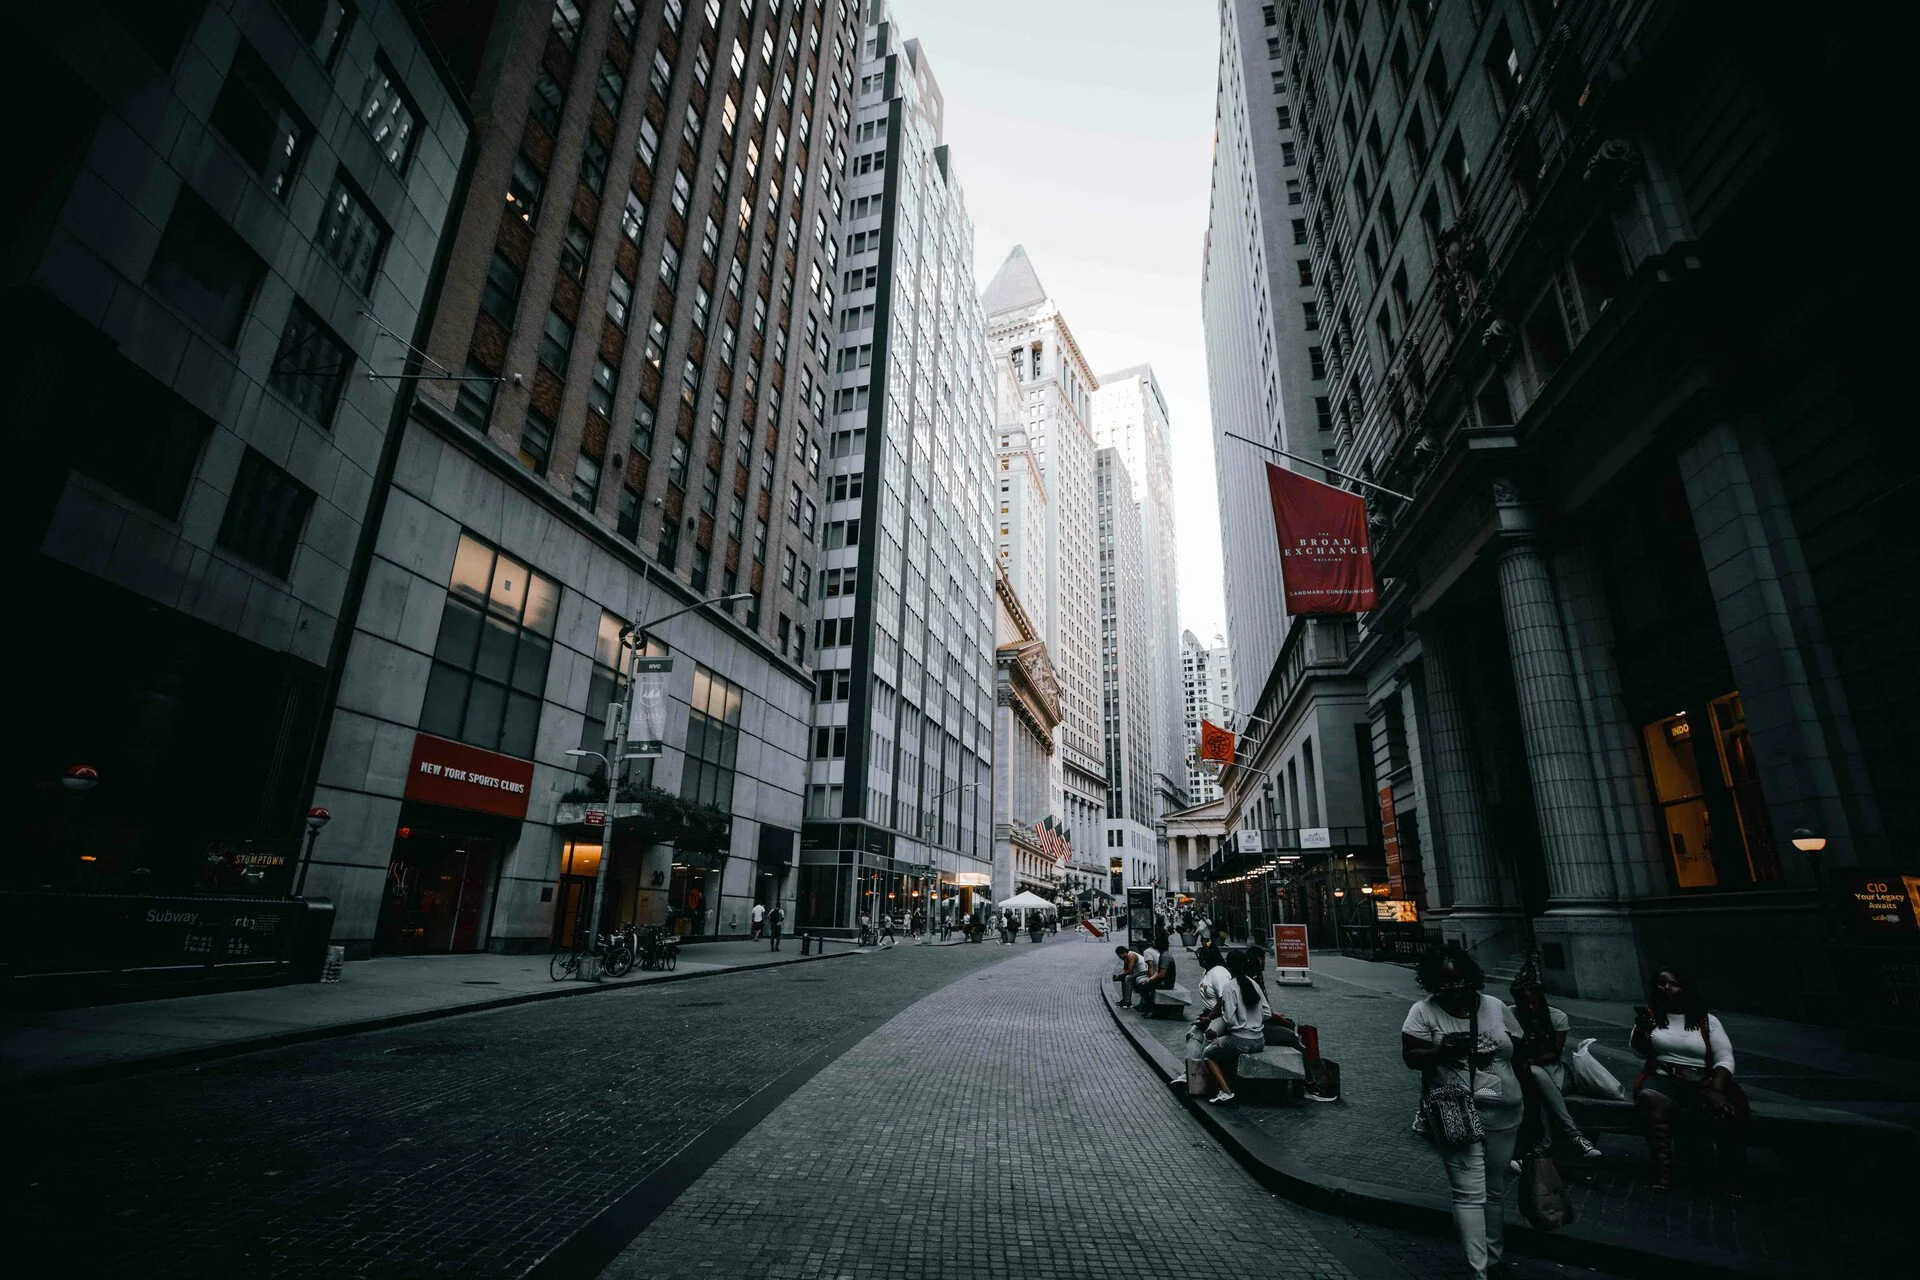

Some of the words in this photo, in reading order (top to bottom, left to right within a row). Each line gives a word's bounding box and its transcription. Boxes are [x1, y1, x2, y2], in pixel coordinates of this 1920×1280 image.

[1300, 538, 1351, 547] BROAD
[1284, 546, 1368, 556] EXCHANGE
[1290, 589, 1324, 597] LANDMARK
[1326, 587, 1375, 595] CONDOMINIUMS
[420, 761, 442, 776] NEW
[444, 766, 467, 781] YORK
[468, 772, 500, 788] SPORTS
[500, 780, 525, 794] CLUBS
[234, 854, 286, 866] STUMPTOWN
[1866, 883, 1888, 893] CIO
[1855, 893, 1875, 901] Your
[1875, 893, 1905, 902] Legacy
[146, 908, 200, 925] Subway
